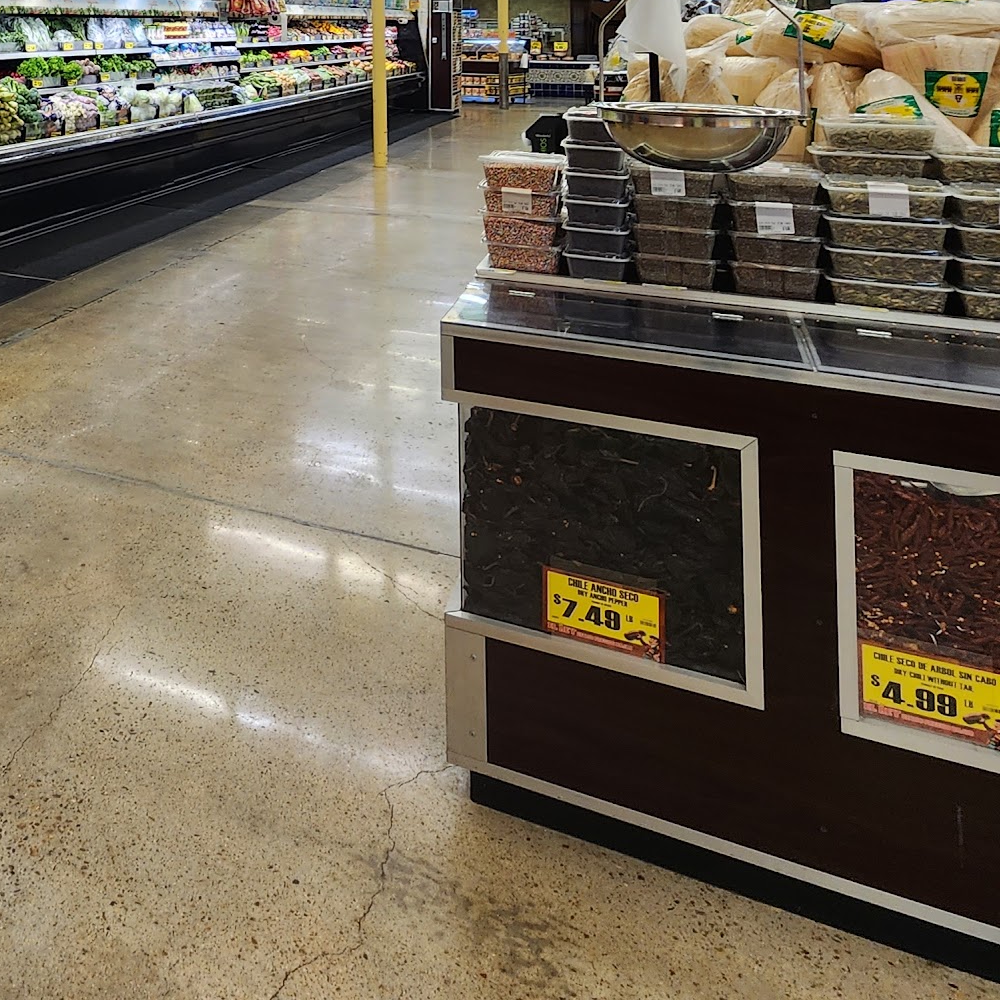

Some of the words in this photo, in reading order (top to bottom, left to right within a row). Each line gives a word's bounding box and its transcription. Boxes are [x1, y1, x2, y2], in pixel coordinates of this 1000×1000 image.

[567, 577, 588, 591] CHILE
[590, 583, 617, 597] ANCHO
[619, 590, 639, 603] SECO
[873, 651, 894, 663] CHILE
[896, 657, 916, 668] SECO
[918, 662, 927, 671] DE
[930, 665, 956, 678] ARBOL
[958, 671, 973, 682] SIN
[975, 675, 997, 686] CABO
